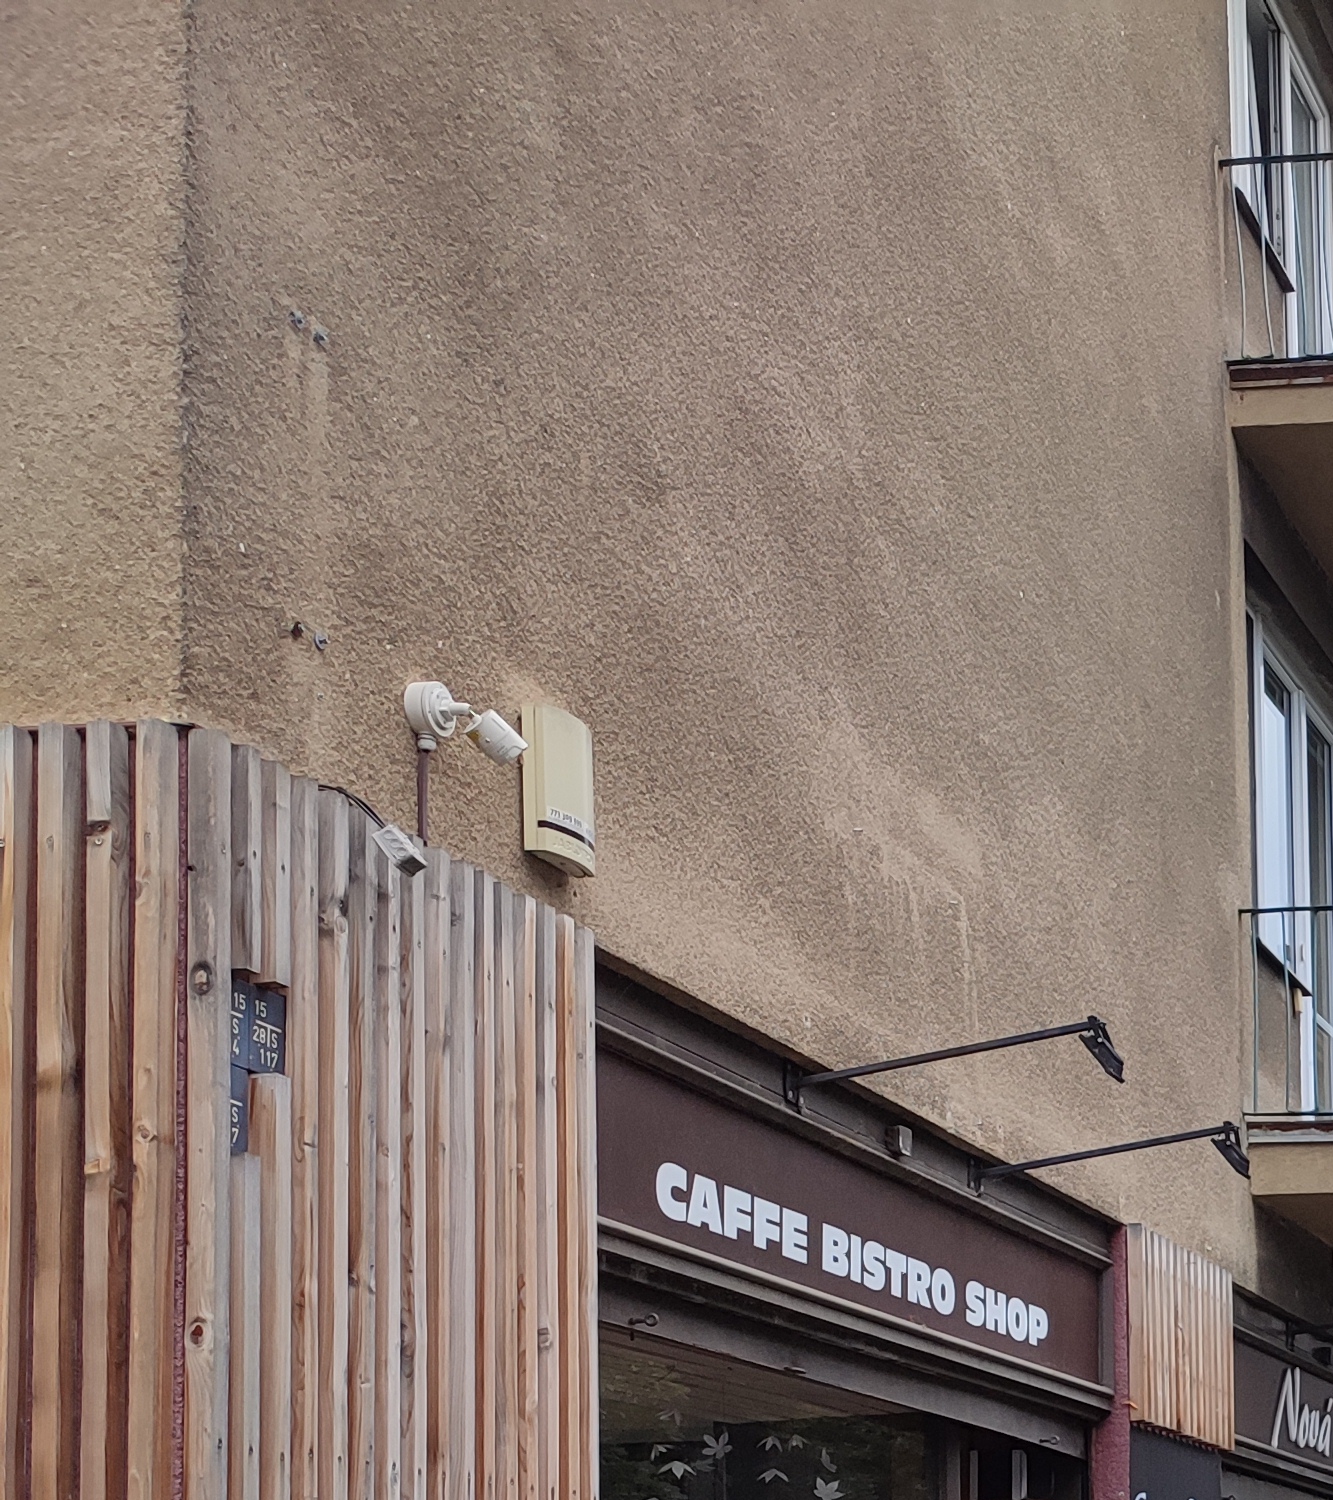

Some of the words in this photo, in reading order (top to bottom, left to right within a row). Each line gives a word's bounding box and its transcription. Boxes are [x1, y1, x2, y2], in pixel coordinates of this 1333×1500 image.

[234, 992, 246, 1010] 15
[255, 999, 267, 1018] 15
[252, 1025, 266, 1044] 28
[271, 1033, 278, 1049] S
[260, 1048, 278, 1068] 117
[655, 1162, 808, 1264] CAFFE
[822, 1222, 956, 1315] BISTRO
[965, 1280, 1048, 1346] SHOP
[1271, 1366, 1333, 1458] Nová
